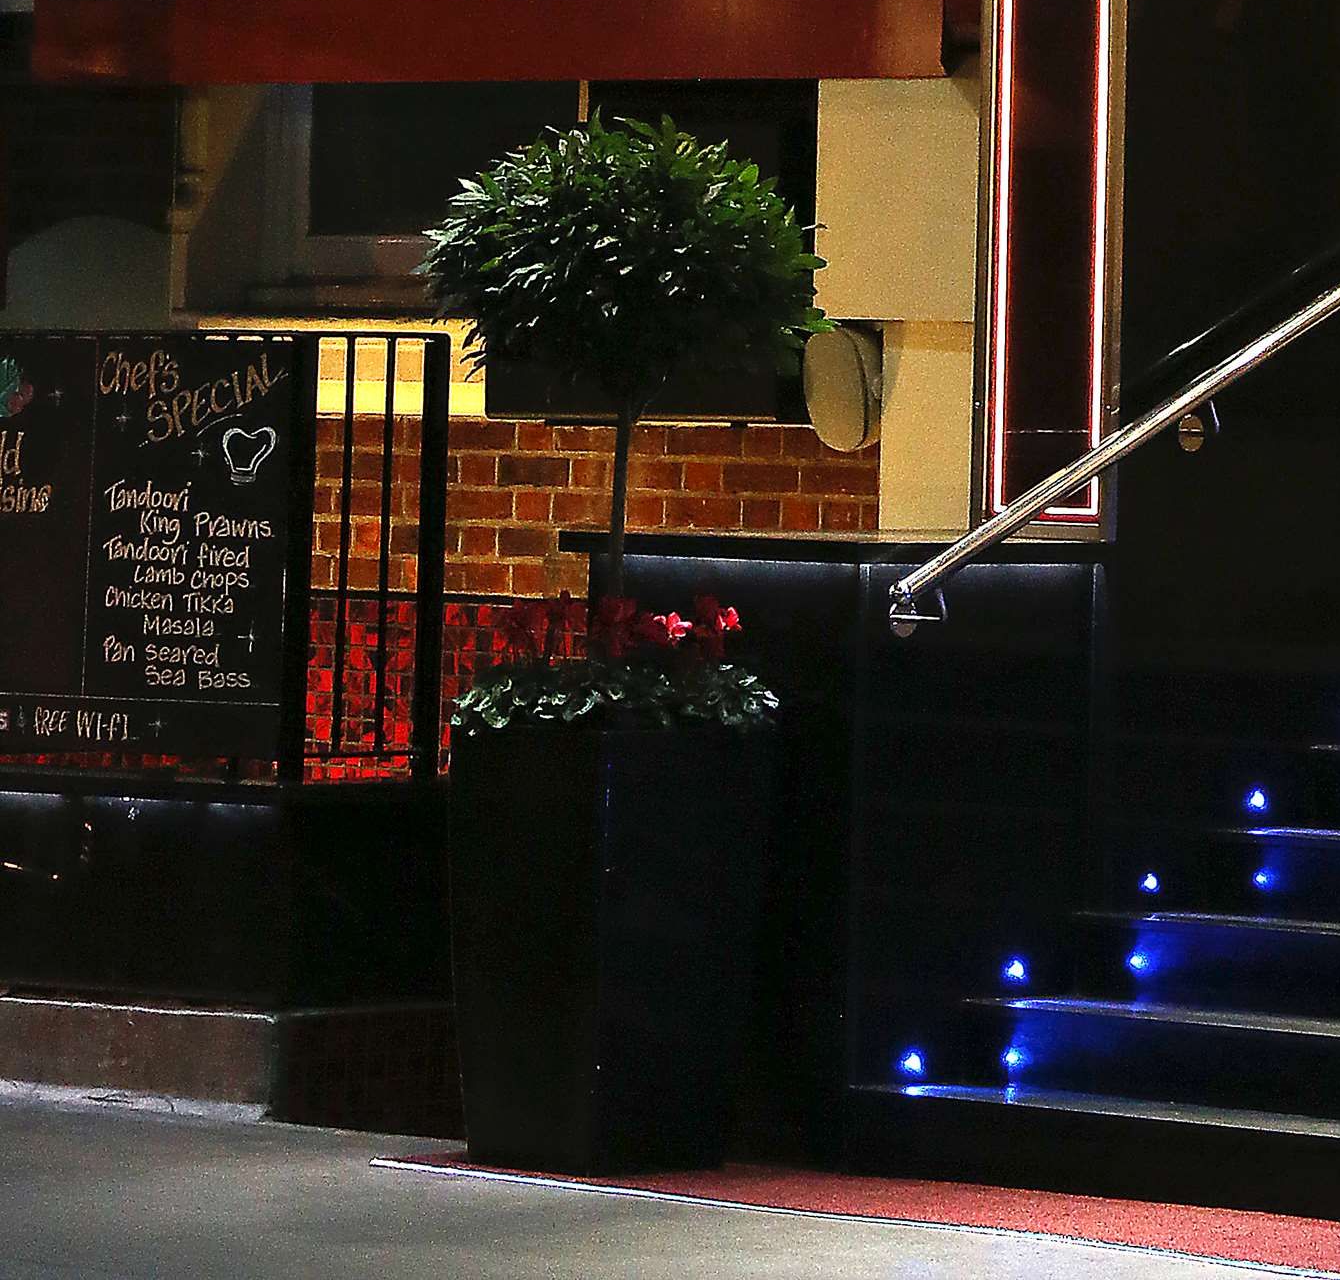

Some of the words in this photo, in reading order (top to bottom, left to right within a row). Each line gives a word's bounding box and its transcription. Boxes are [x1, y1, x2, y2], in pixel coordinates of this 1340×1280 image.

[100, 349, 180, 399] Chef's
[147, 352, 288, 442] SPECIAL
[104, 479, 192, 513] Tandoori
[139, 509, 181, 545] King
[102, 534, 190, 565] Tandoori
[133, 565, 186, 585] Lamb
[105, 586, 173, 612] Chicken
[143, 614, 215, 638] Masala
[102, 634, 135, 662] Pan
[144, 665, 186, 686] Sea
[198, 670, 251, 689] Bass
